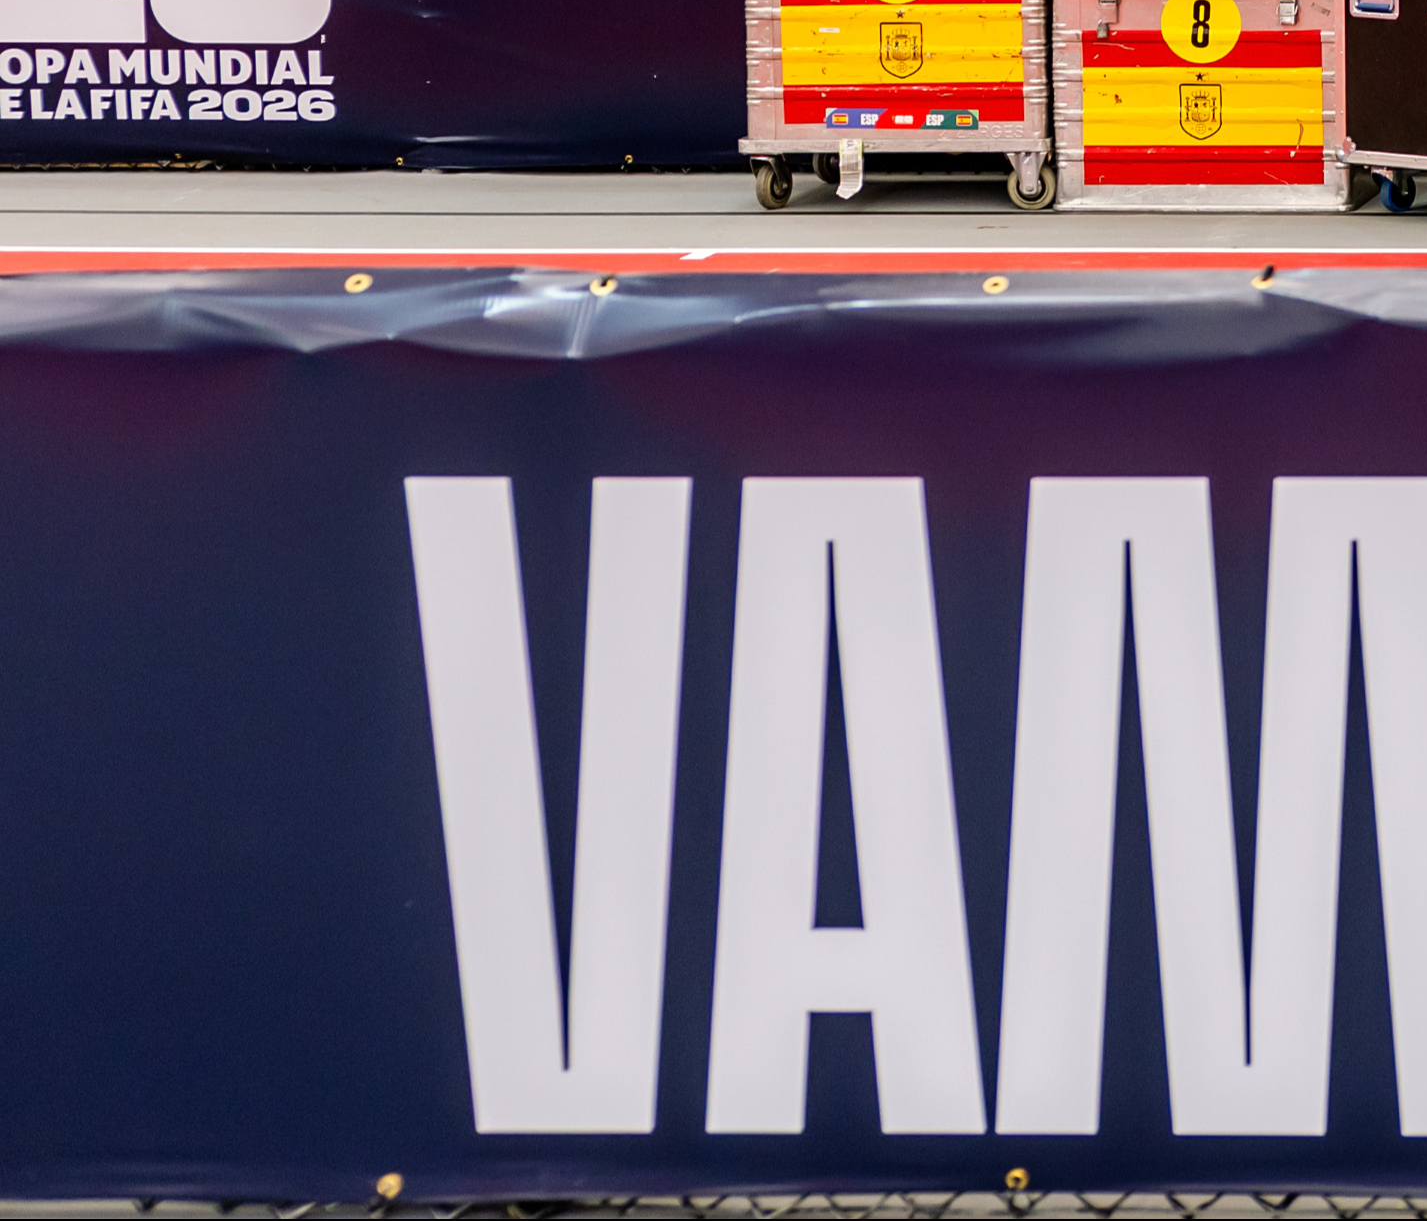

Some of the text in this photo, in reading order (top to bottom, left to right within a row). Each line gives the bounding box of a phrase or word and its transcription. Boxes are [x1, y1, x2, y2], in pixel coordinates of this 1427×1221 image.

[0, 48, 335, 86] OPA MUNDIAL
[29, 89, 87, 120] LA
[90, 89, 182, 121] FIFA
[187, 89, 336, 122] 2026
[860, 113, 878, 126] ESP
[926, 114, 944, 126] ESP
